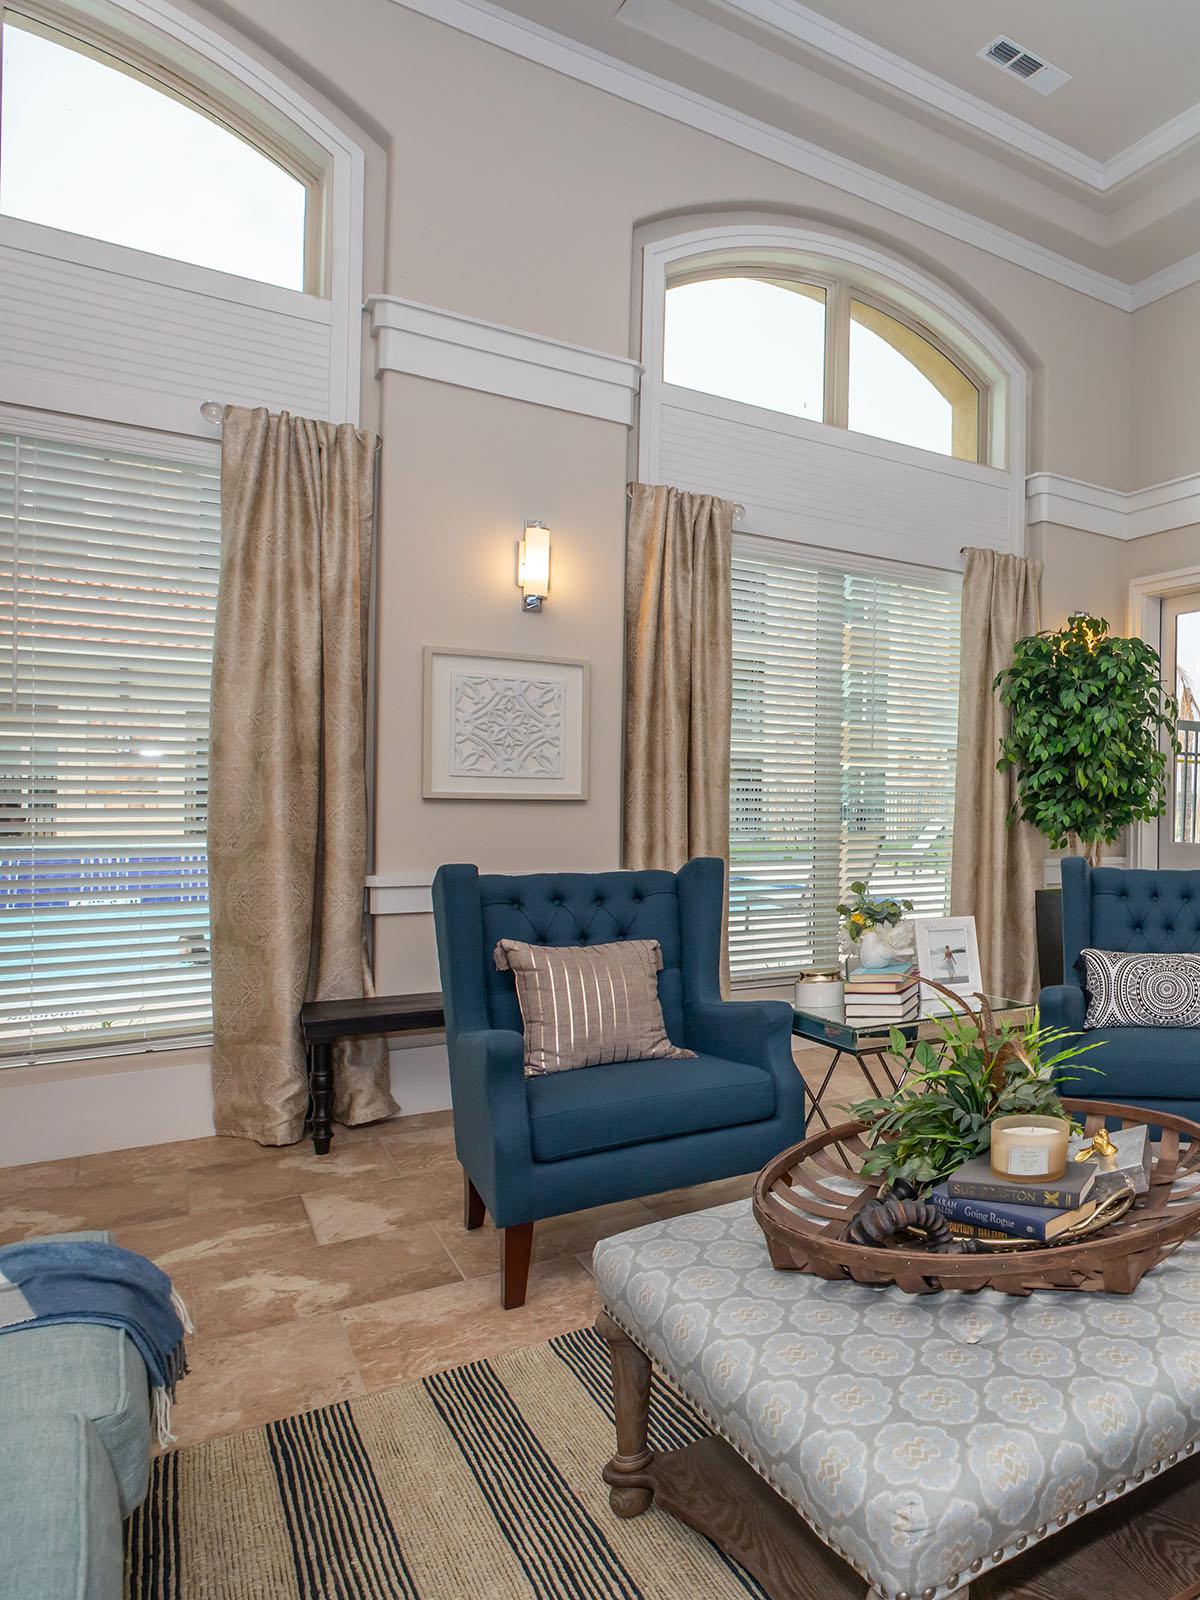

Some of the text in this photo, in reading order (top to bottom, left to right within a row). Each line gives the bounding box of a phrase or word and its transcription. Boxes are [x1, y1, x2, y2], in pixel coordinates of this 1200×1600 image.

[932, 1197, 957, 1209] SARAH
[964, 1206, 1015, 1229] Going Rogue
